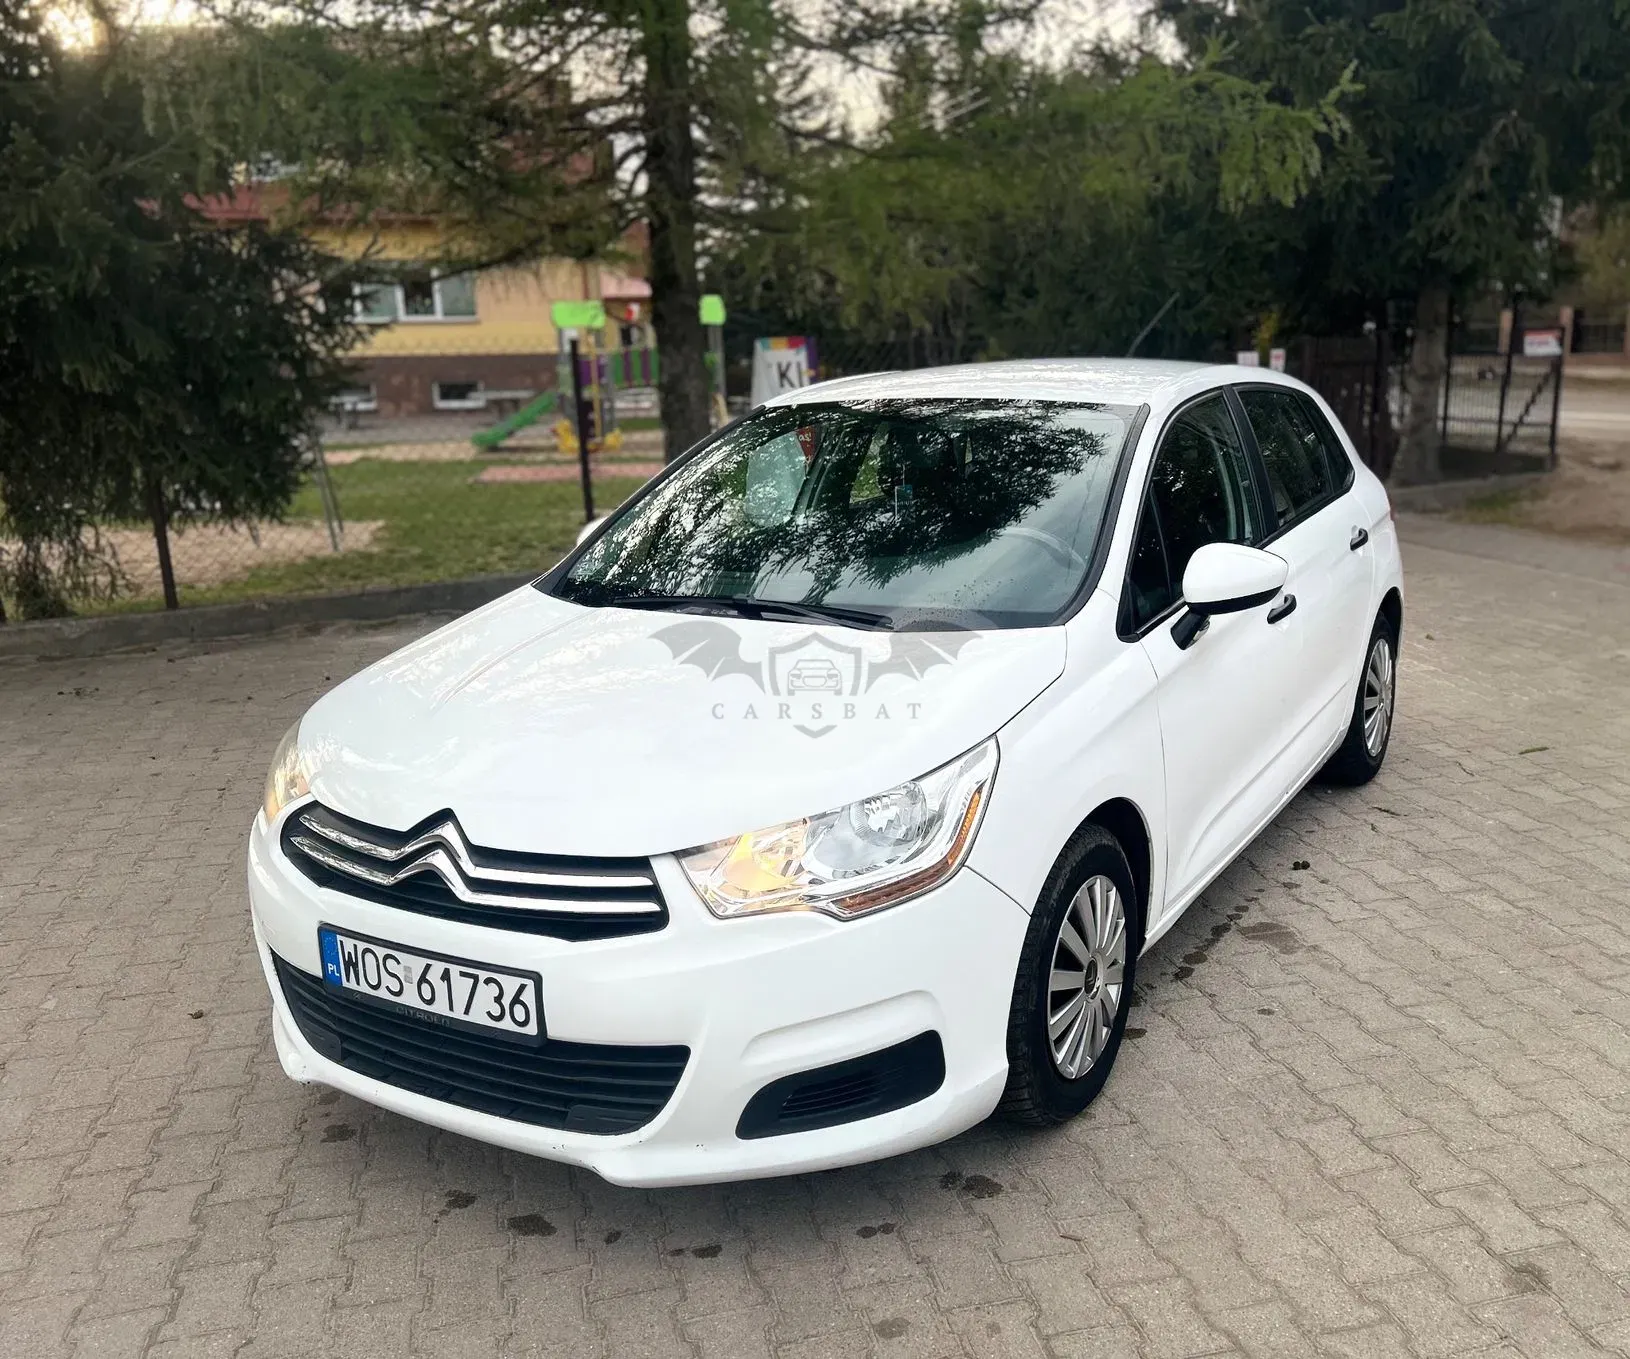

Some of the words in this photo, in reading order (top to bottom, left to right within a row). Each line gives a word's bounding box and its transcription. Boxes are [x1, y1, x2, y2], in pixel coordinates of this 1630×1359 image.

[327, 962, 340, 977] PL
[339, 939, 404, 997] WOS
[416, 962, 531, 1028] 61736
